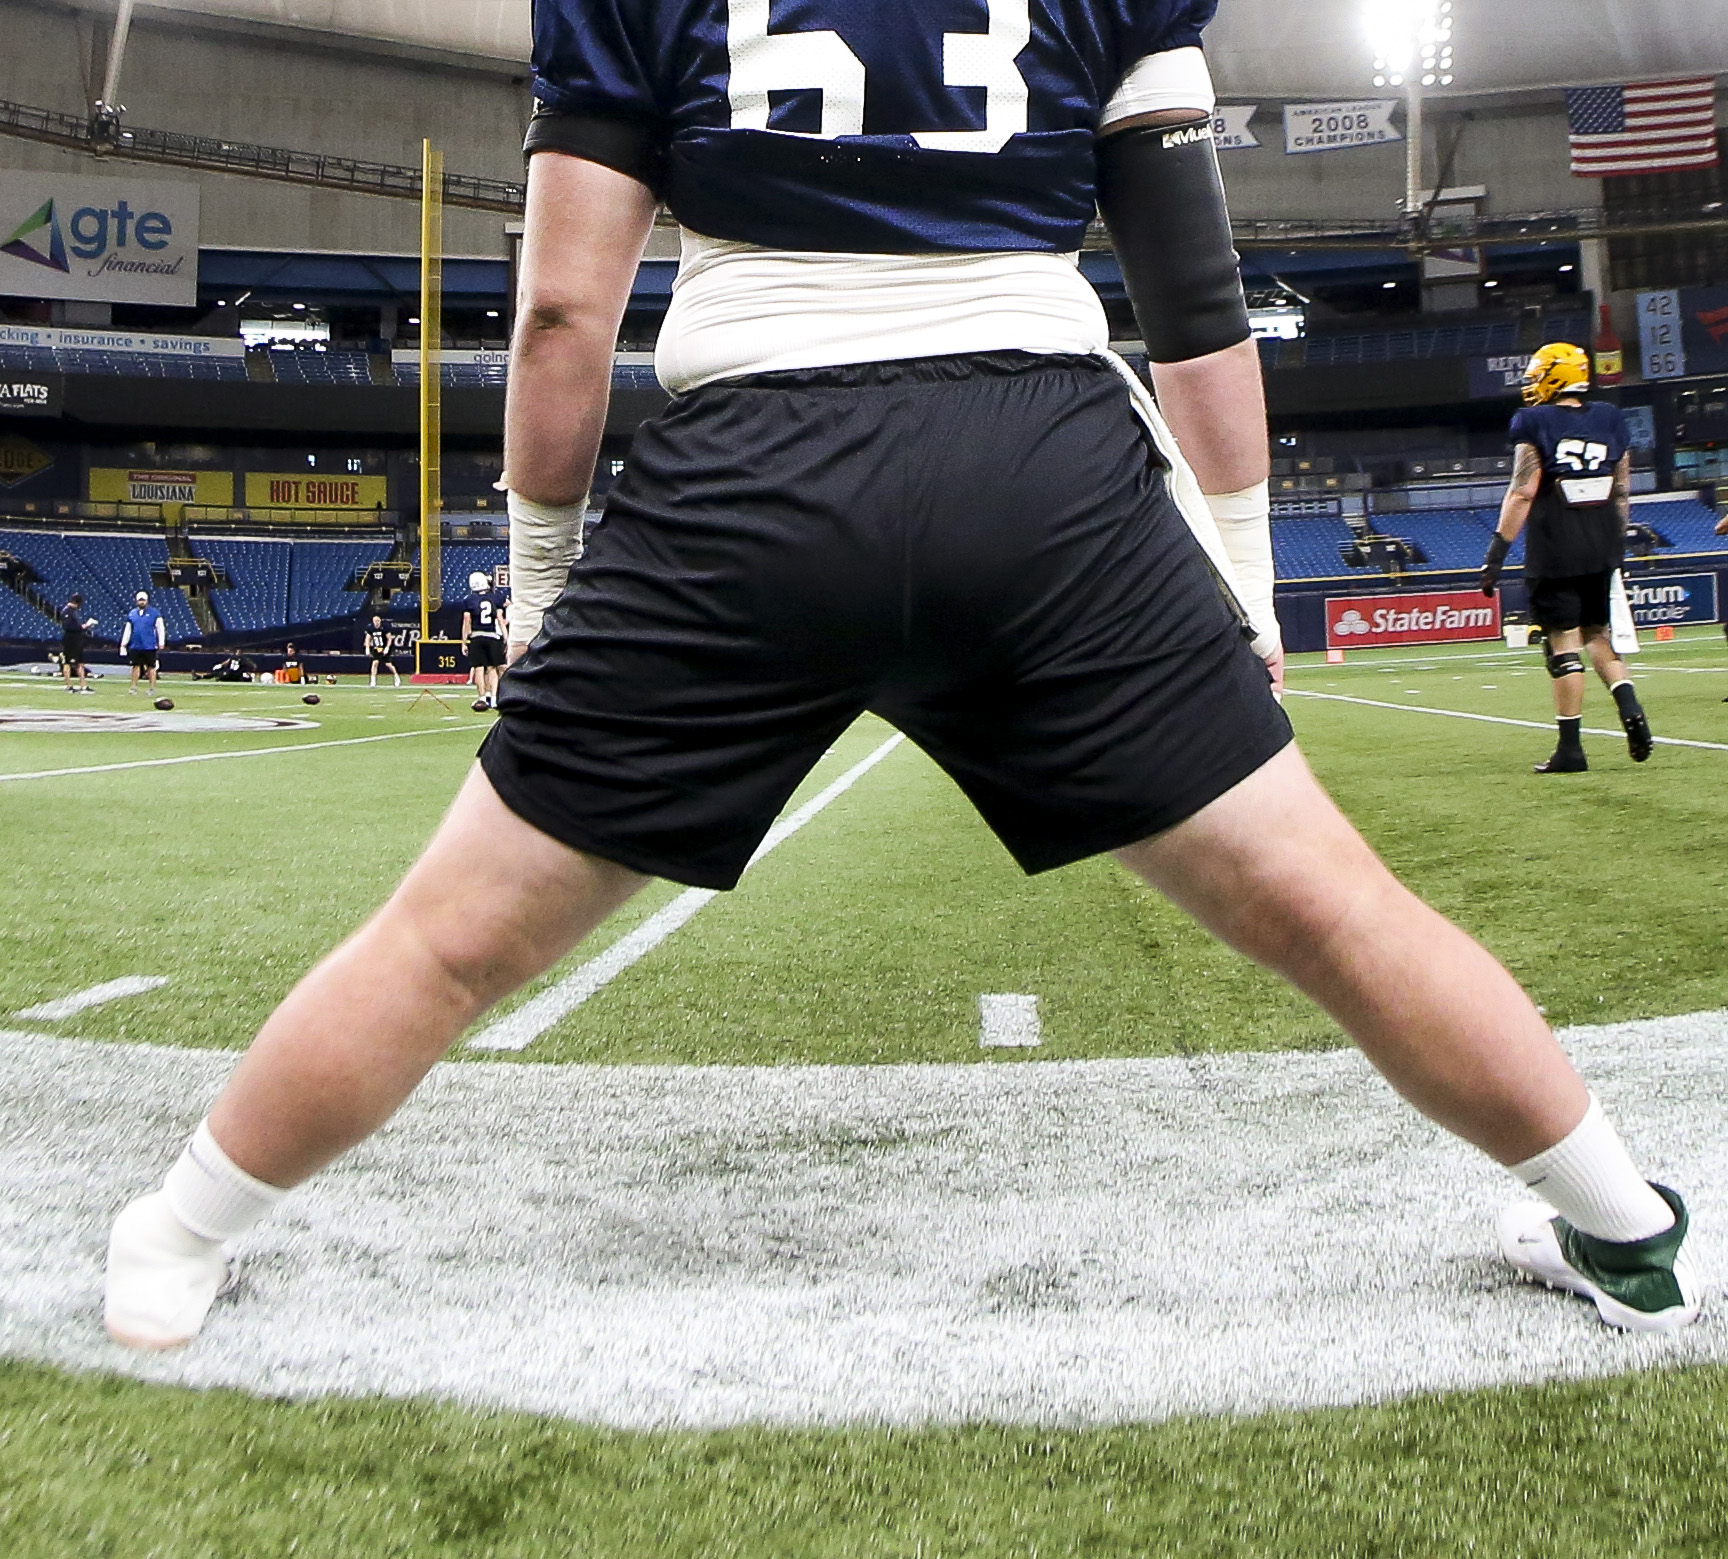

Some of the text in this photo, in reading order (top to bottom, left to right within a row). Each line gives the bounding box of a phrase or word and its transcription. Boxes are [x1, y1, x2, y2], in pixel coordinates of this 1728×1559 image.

[1311, 114, 1369, 134] 2008
[1294, 130, 1386, 147] CHAMPIONS
[70, 200, 172, 259] gte
[88, 252, 184, 277] financial
[1646, 296, 1673, 315] 42
[59, 332, 132, 346] insurance
[152, 338, 210, 355] savings
[1651, 324, 1673, 345] 12
[1487, 355, 1530, 371] REPU
[12, 384, 49, 399] FLATS
[132, 484, 194, 501] LOUISIANA
[271, 480, 359, 505] HOT SAUCE
[480, 601, 492, 624] 2
[438, 656, 456, 668] 315
